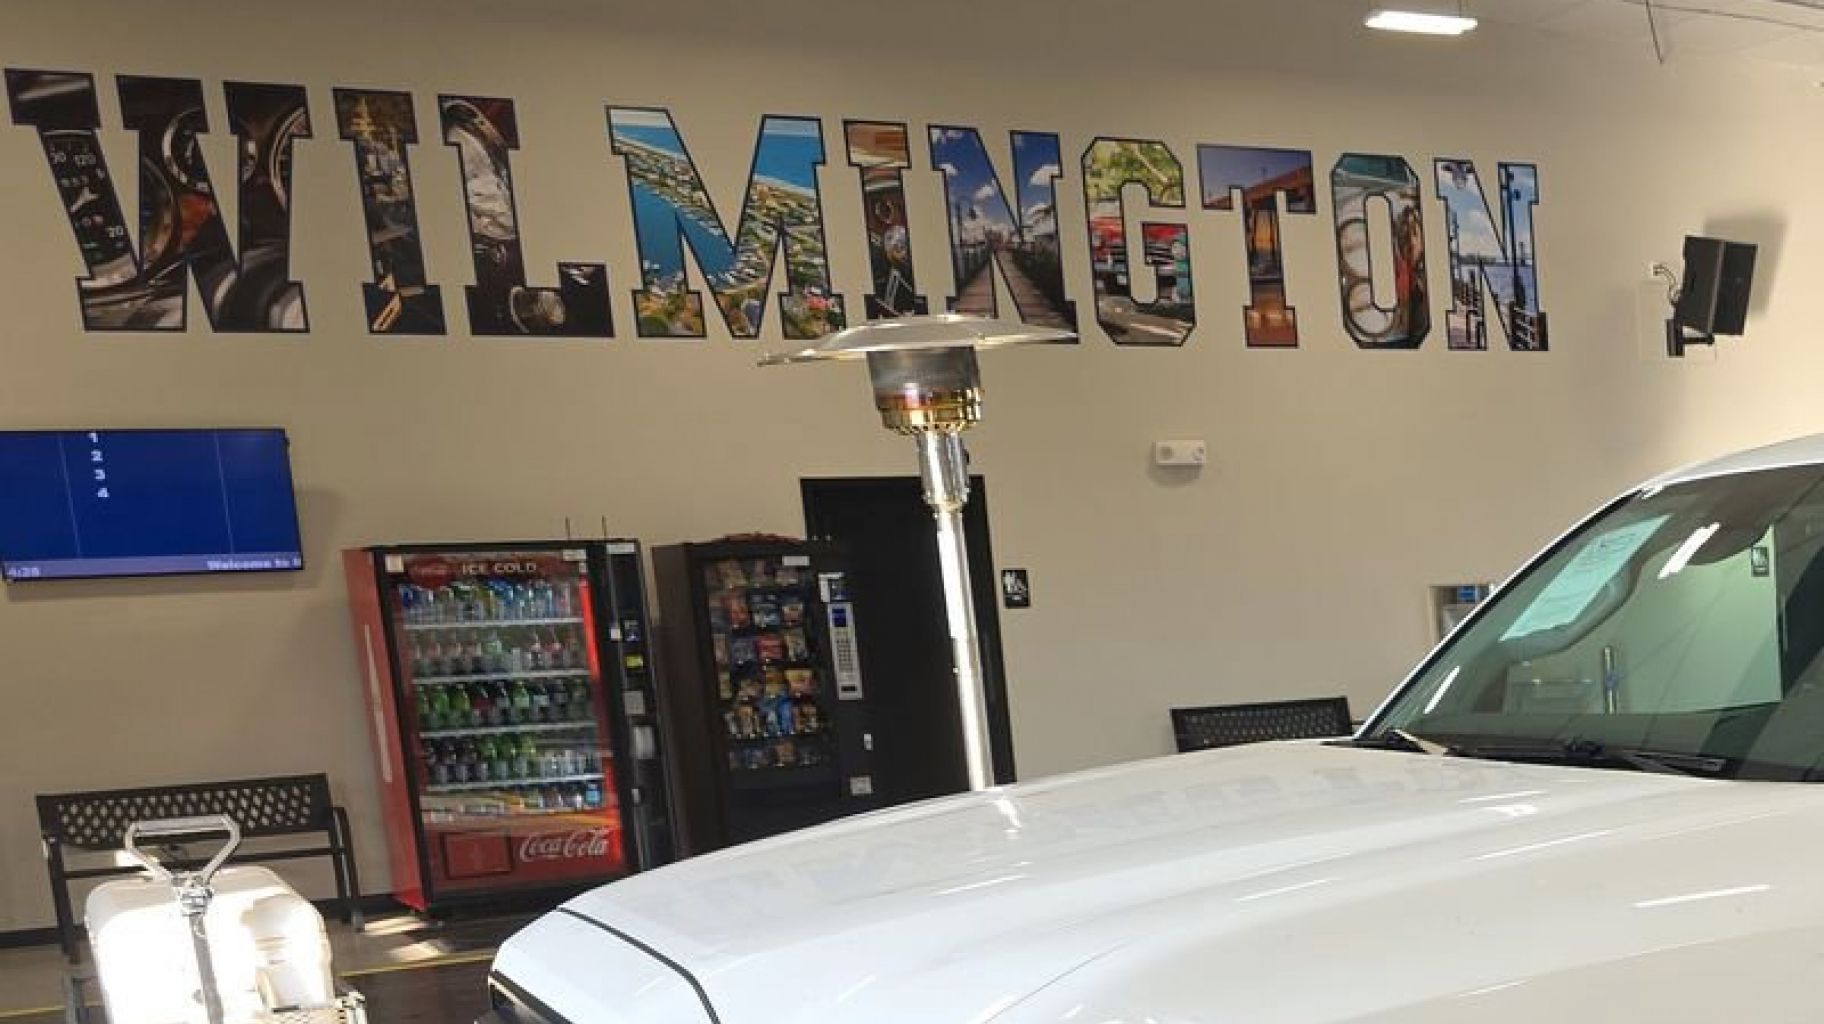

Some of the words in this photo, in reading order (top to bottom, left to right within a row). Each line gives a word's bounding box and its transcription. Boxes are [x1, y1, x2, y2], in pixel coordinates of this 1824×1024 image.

[4, 68, 1550, 352] WILMINGTON
[88, 432, 99, 443] 1
[91, 450, 103, 462] 2
[95, 469, 106, 480] 3
[98, 487, 110, 499] 4
[207, 559, 272, 571] Welcome
[462, 562, 487, 576] ICE
[494, 560, 538, 575] COLD
